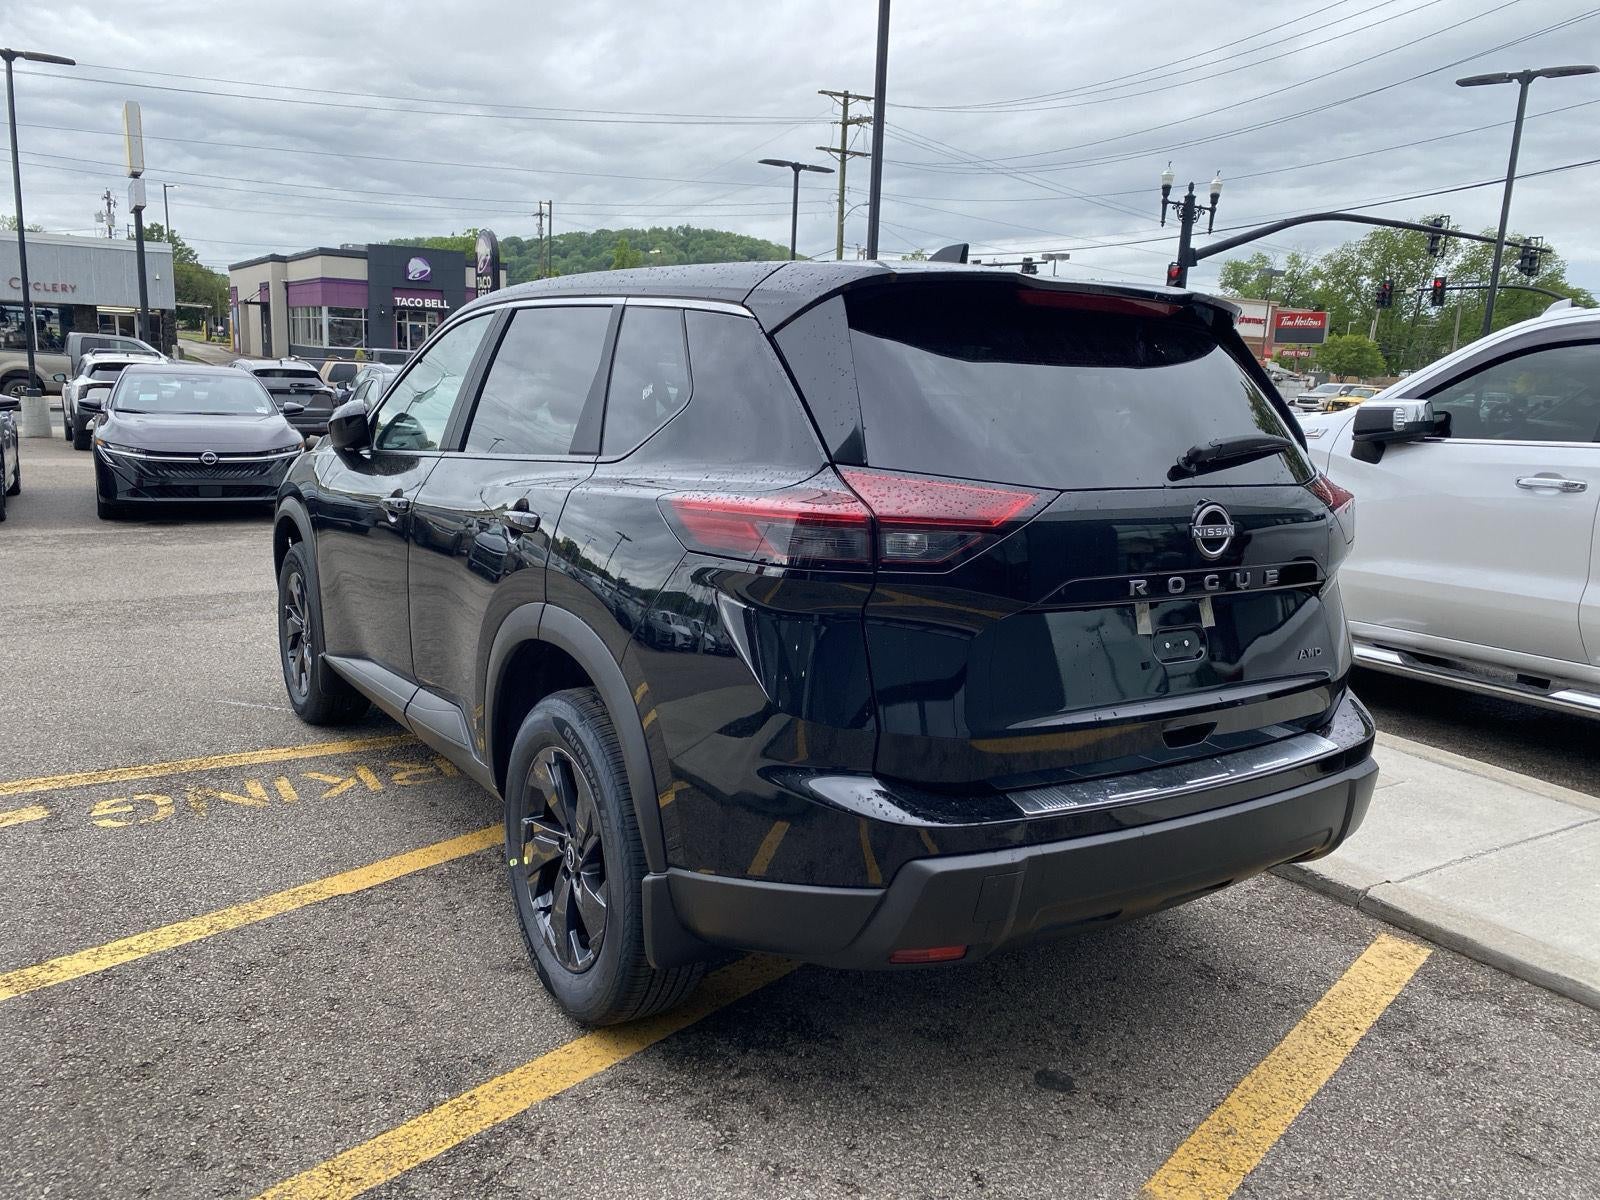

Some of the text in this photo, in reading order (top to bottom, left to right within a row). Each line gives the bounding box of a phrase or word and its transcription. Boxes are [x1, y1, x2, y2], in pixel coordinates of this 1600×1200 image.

[8, 277, 77, 293] CCLERY
[477, 276, 491, 289] TACO
[394, 297, 450, 309] TACO BELL
[1280, 315, 1322, 327] Tim Hortons
[1193, 525, 1235, 537] NISSAN
[1129, 569, 1280, 596] ROGUE
[1297, 647, 1322, 661] AWD
